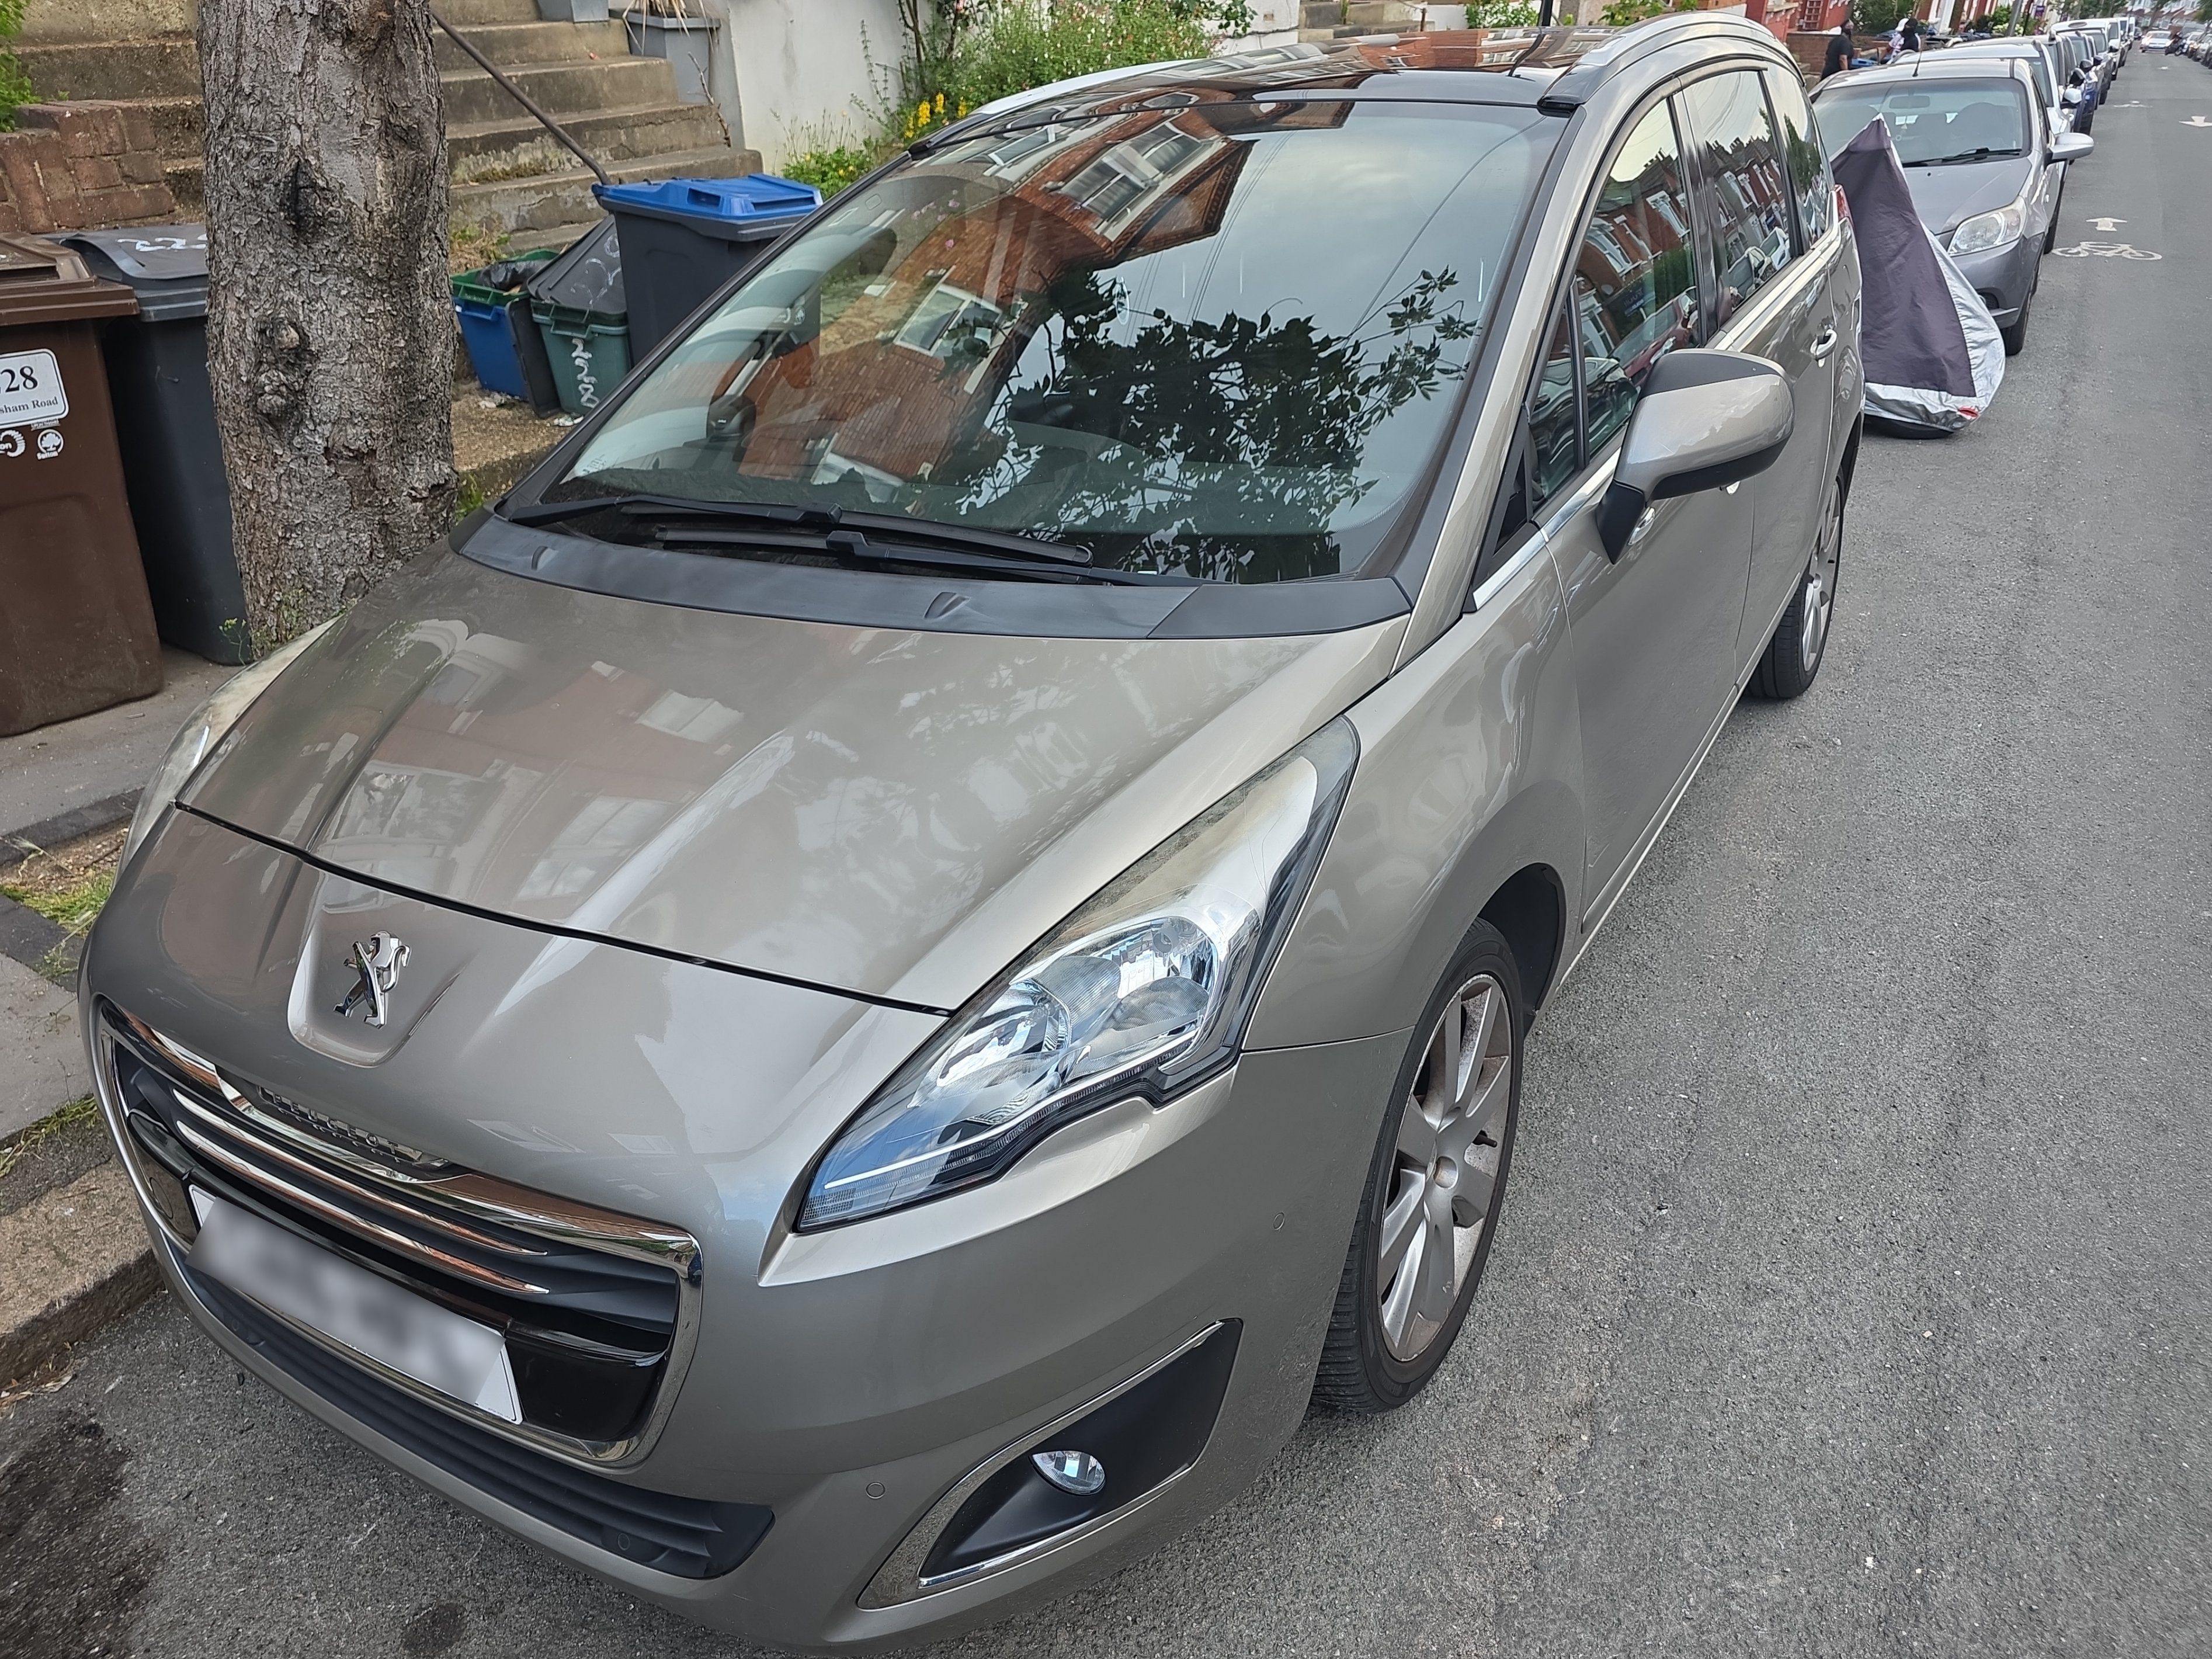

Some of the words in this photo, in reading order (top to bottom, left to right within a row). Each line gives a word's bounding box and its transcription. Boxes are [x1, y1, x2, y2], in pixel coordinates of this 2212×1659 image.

[117, 234, 207, 252] 22
[0, 365, 38, 393] 28
[32, 396, 58, 409] Road
